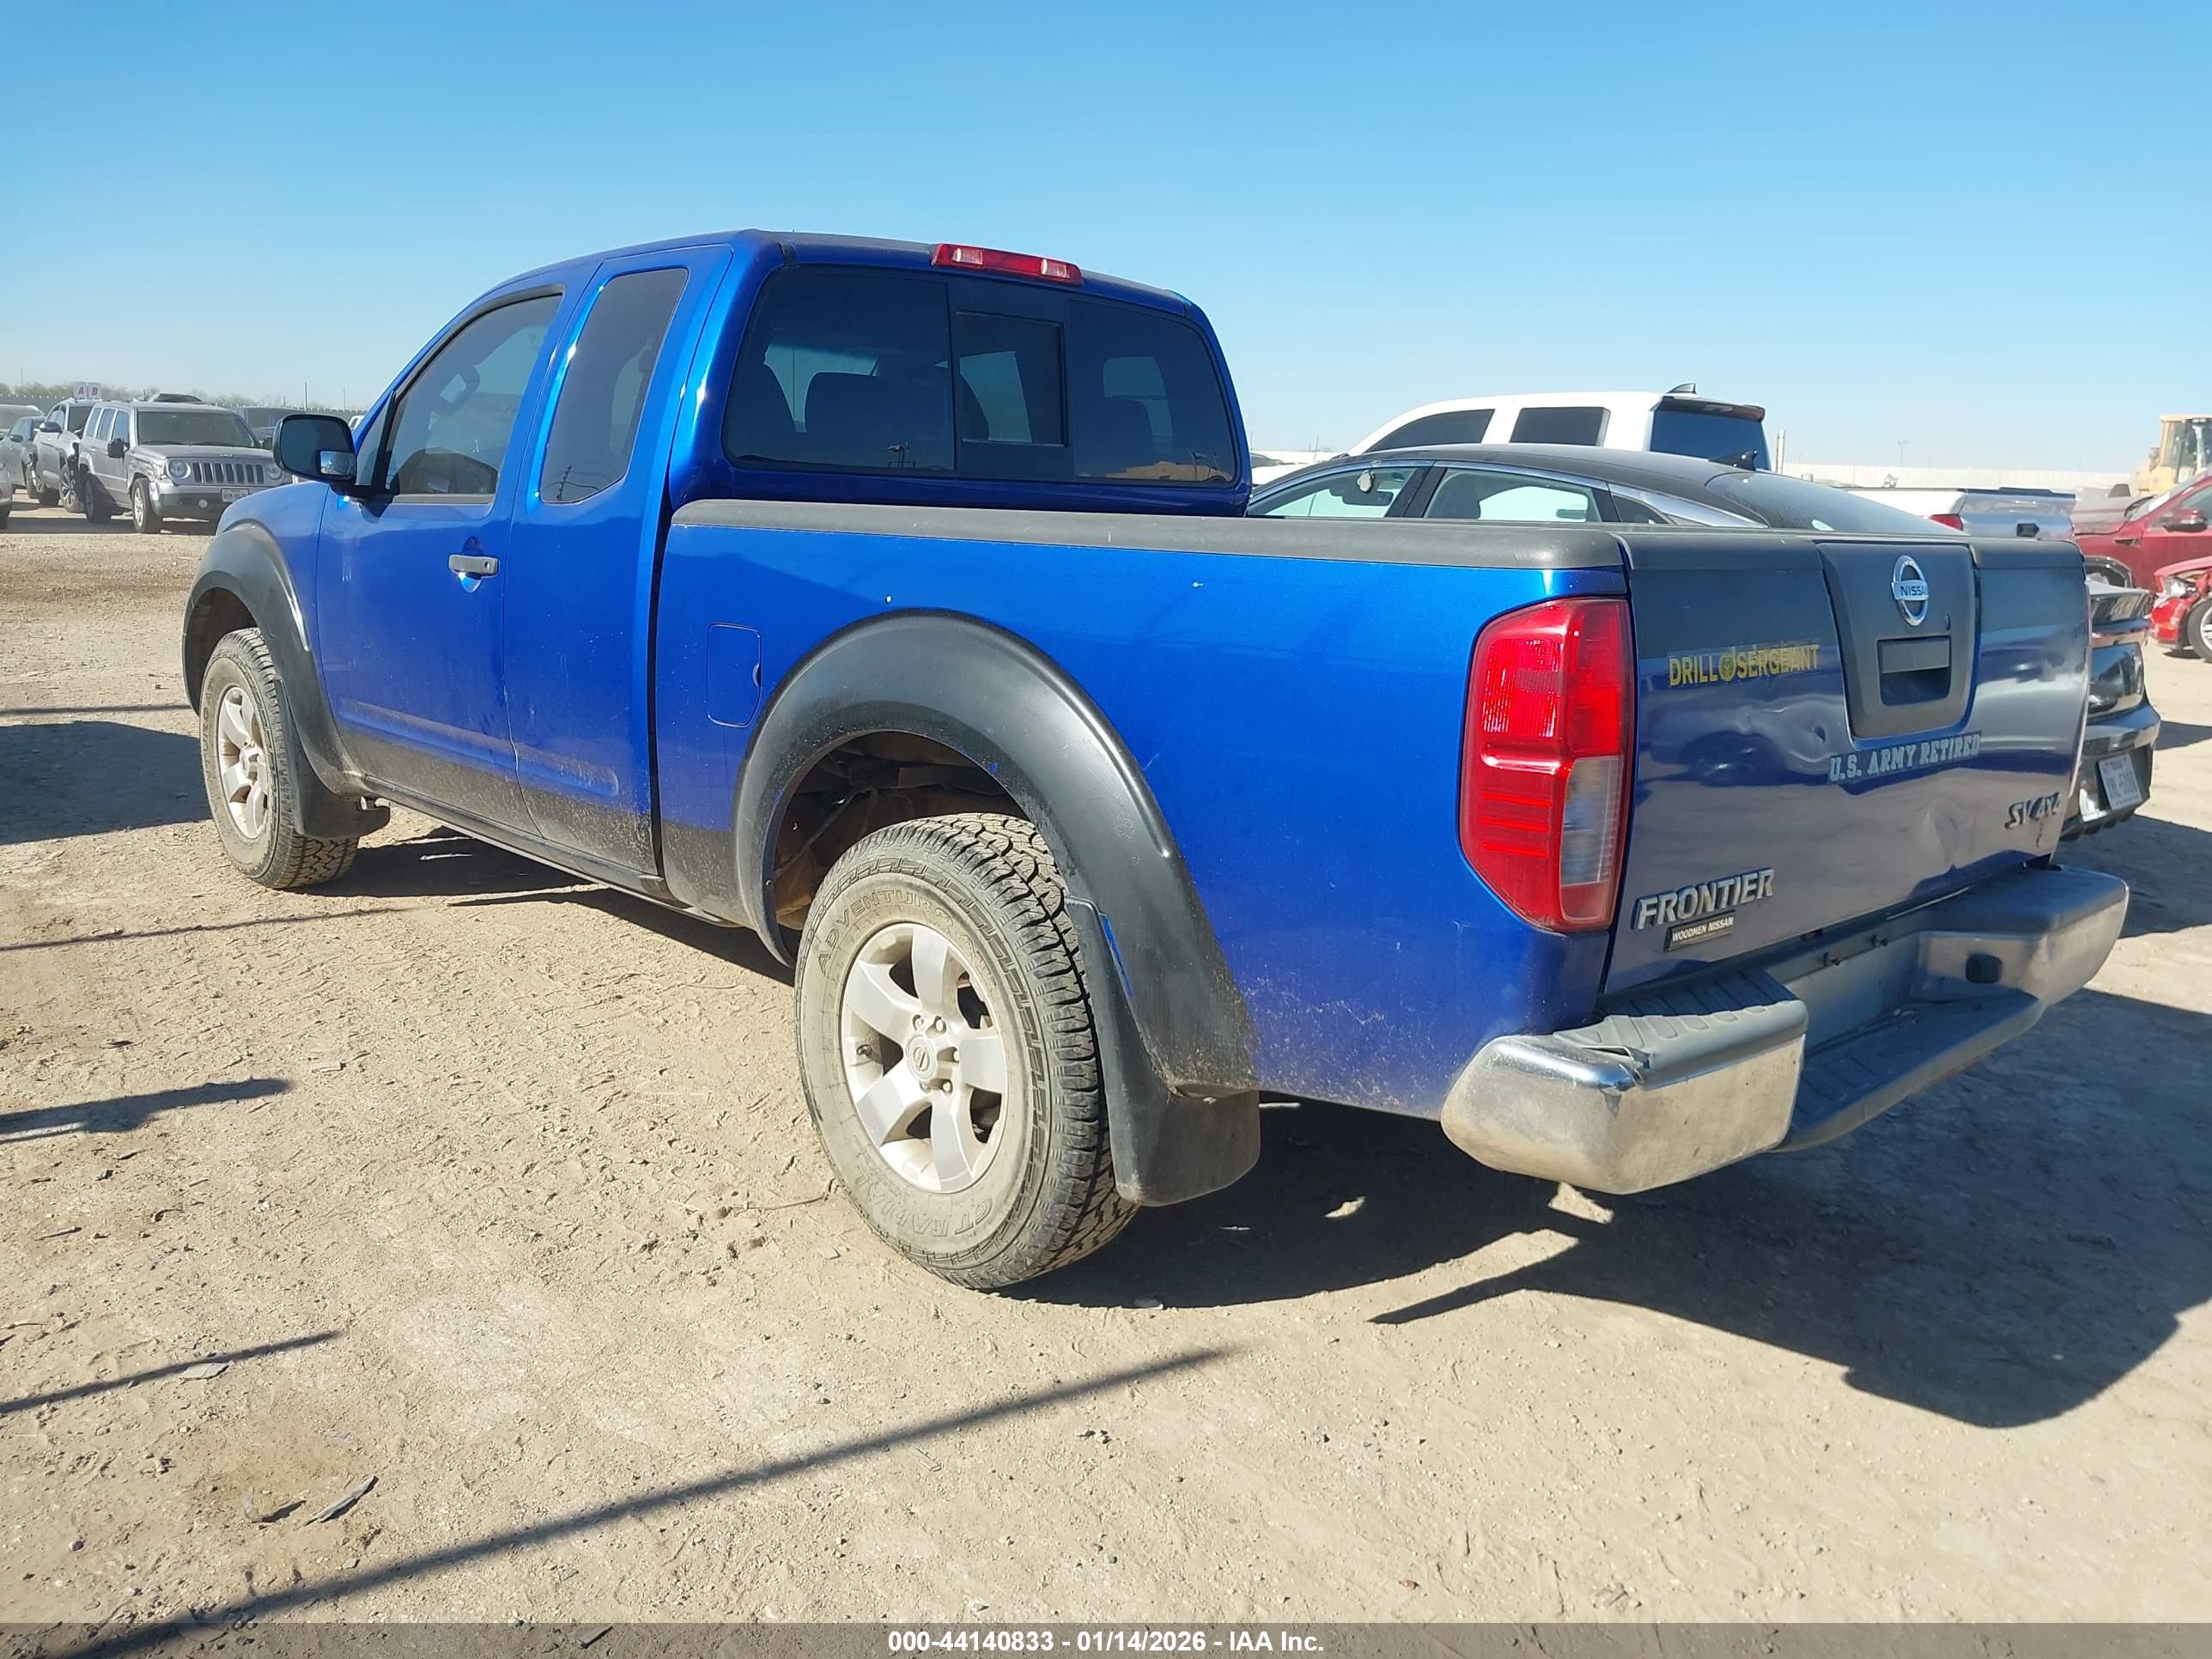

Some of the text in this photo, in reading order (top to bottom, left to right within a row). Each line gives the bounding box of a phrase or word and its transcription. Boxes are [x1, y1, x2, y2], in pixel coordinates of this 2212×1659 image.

[1668, 644, 1820, 686] DRILL SERGEANT
[1829, 732, 1982, 782] U.S. ARMY RETIRED
[1632, 867, 1775, 930] FRONTIER
[1707, 916, 1735, 933] NISSAN
